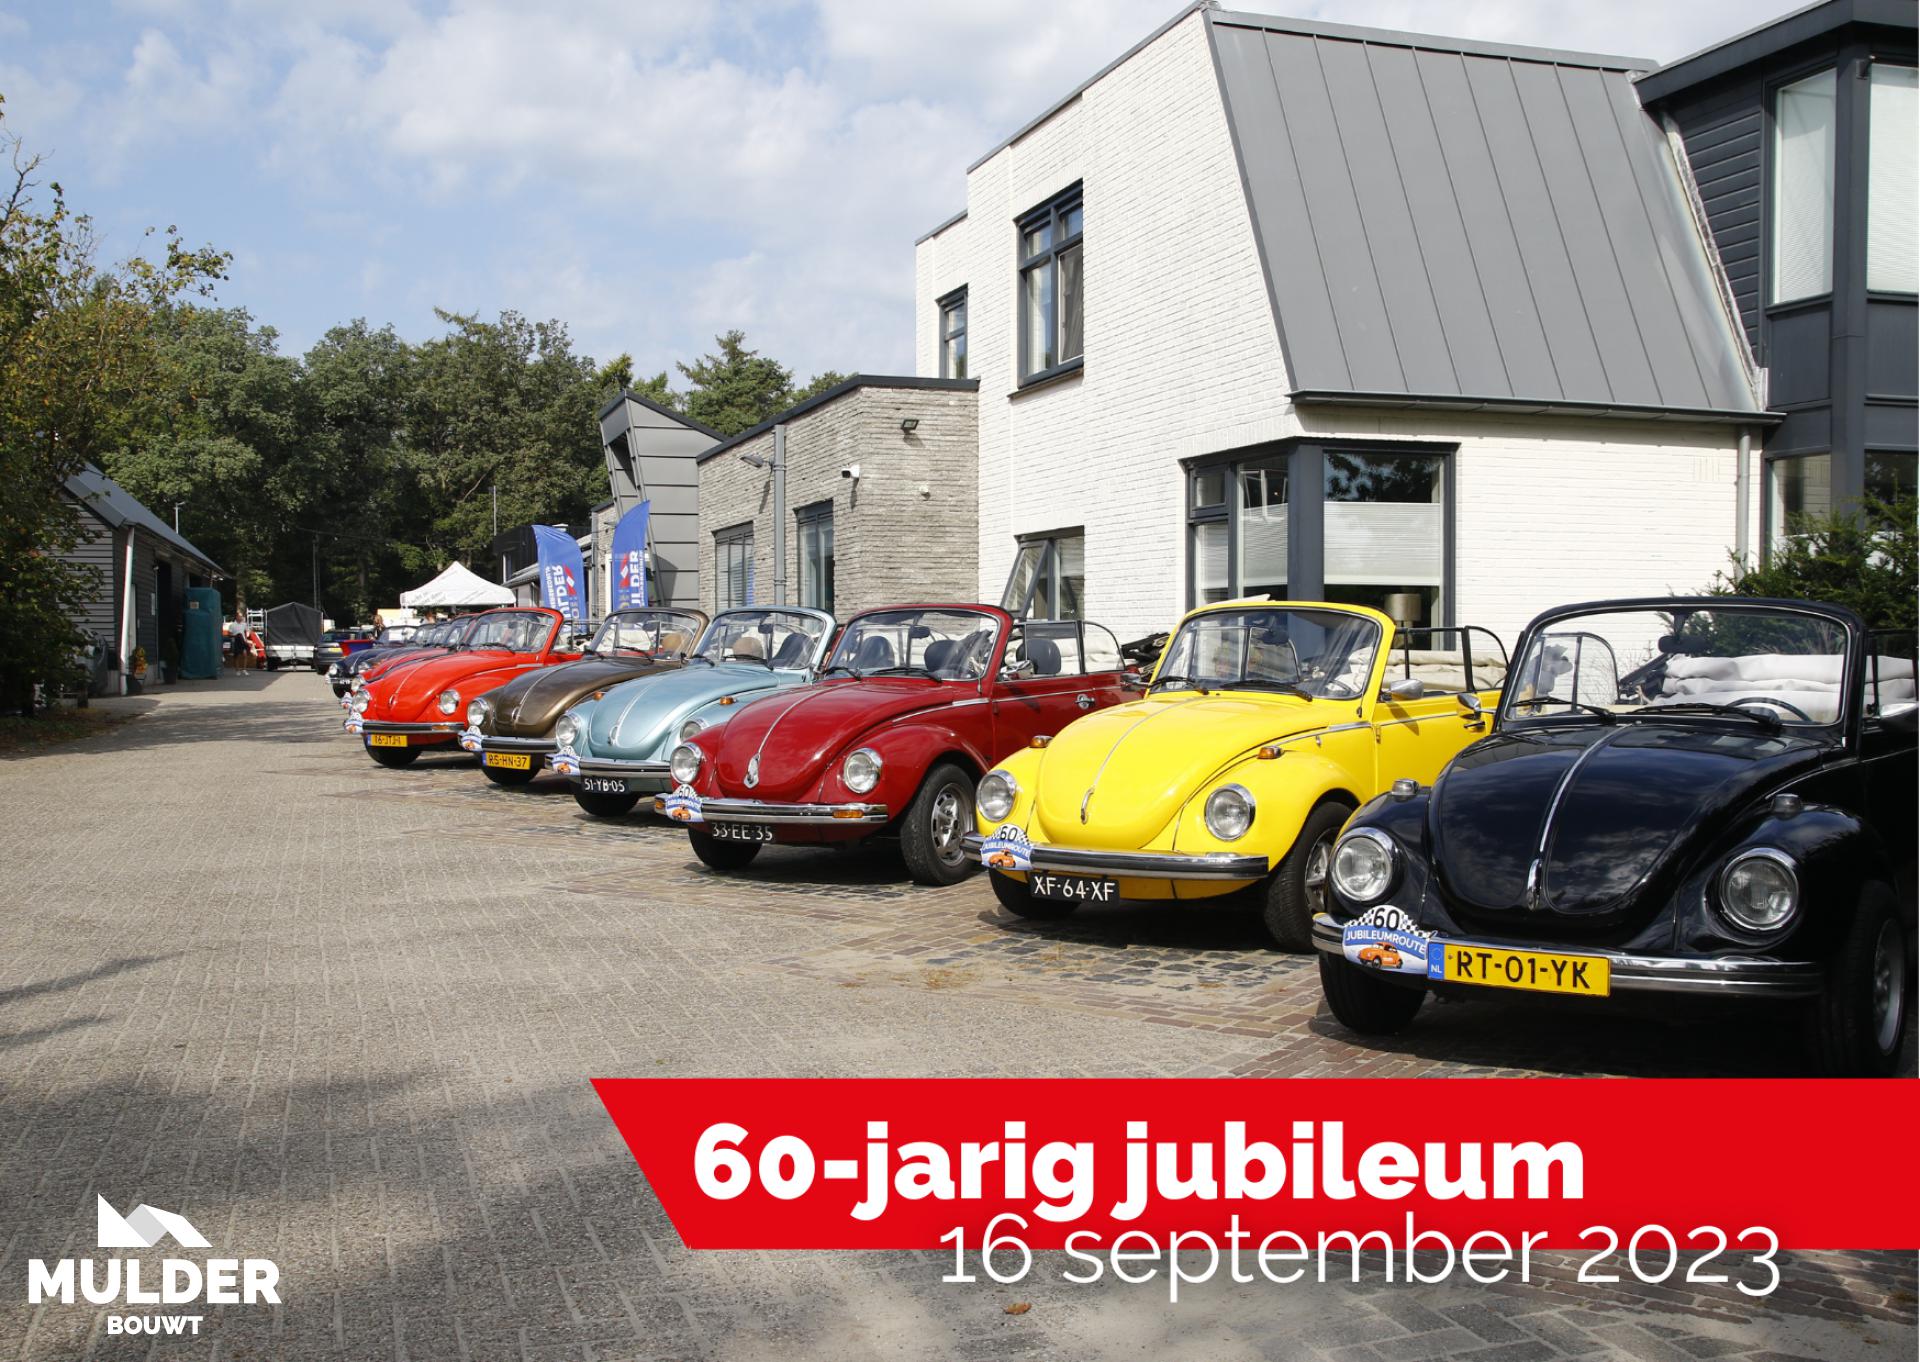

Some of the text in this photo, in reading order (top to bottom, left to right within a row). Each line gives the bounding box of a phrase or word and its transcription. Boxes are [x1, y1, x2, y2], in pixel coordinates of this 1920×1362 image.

[584, 778, 625, 793] 51-YB-05
[712, 822, 773, 841] 33-EE-35
[1000, 825, 1018, 842] 60
[1034, 875, 1116, 902] XF-64-XF
[1372, 906, 1401, 932] 60
[1345, 929, 1427, 954] JUBILEUMROUTE
[1430, 965, 1443, 975] NL
[1456, 949, 1591, 990] RT-01-YK
